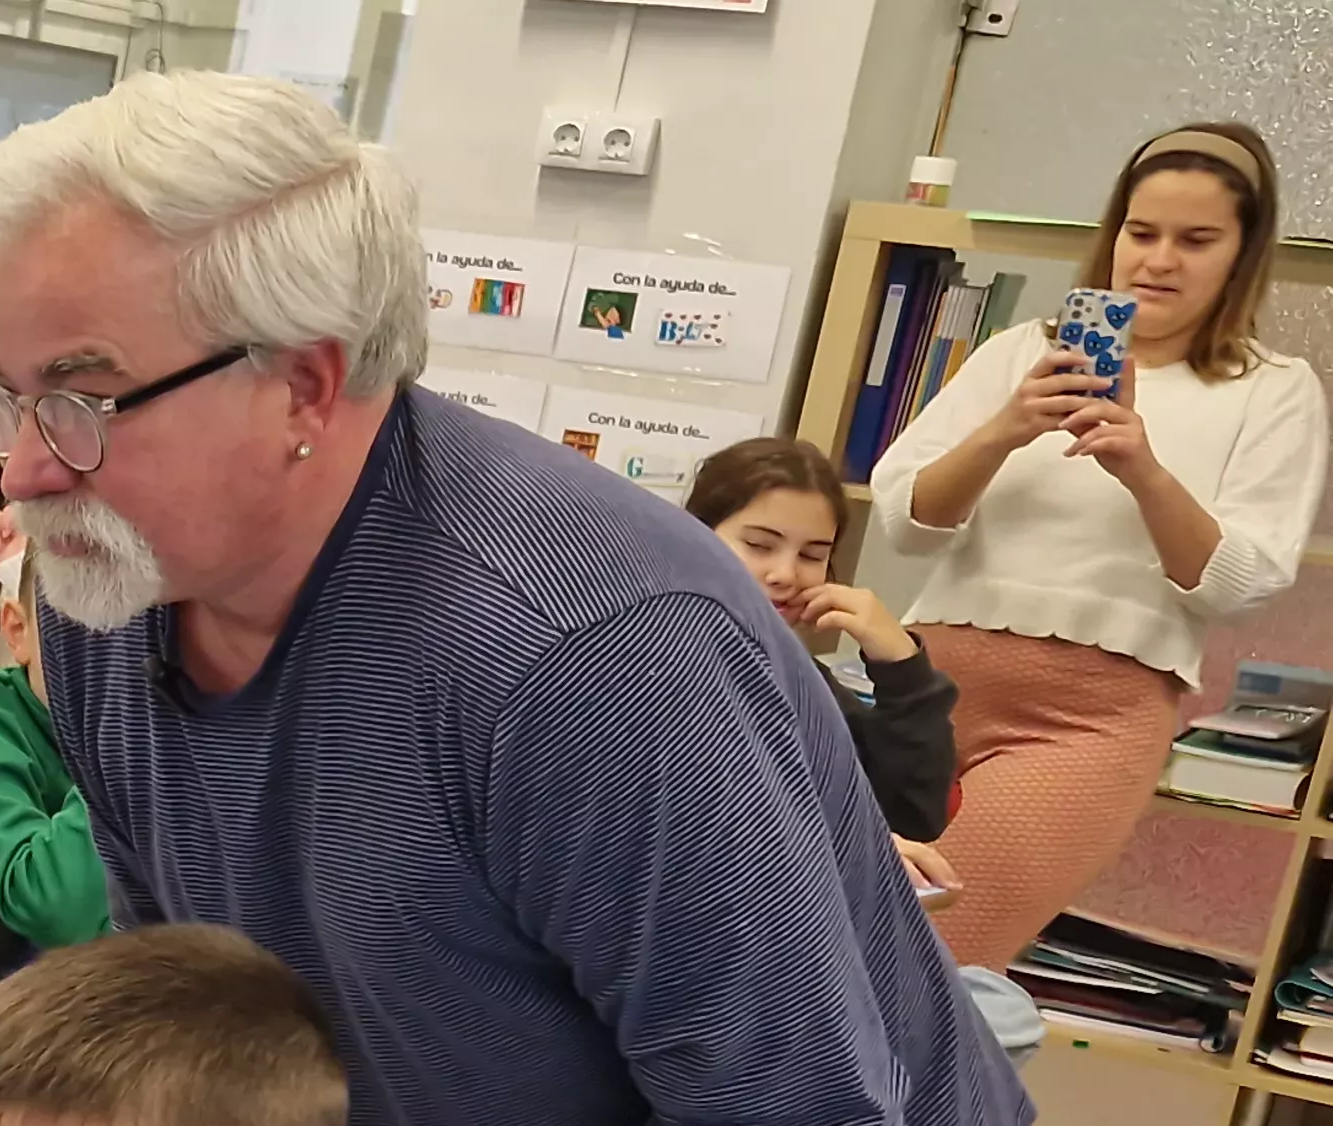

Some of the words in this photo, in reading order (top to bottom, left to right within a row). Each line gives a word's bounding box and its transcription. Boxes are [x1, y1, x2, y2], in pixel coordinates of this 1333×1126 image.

[436, 251, 448, 263] la
[451, 255, 493, 268] ayuda
[613, 272, 640, 286] Con
[644, 274, 656, 287] la
[660, 279, 704, 293] ayuda
[588, 412, 615, 426] Con
[619, 416, 631, 428] la
[634, 420, 678, 434] ayuda
